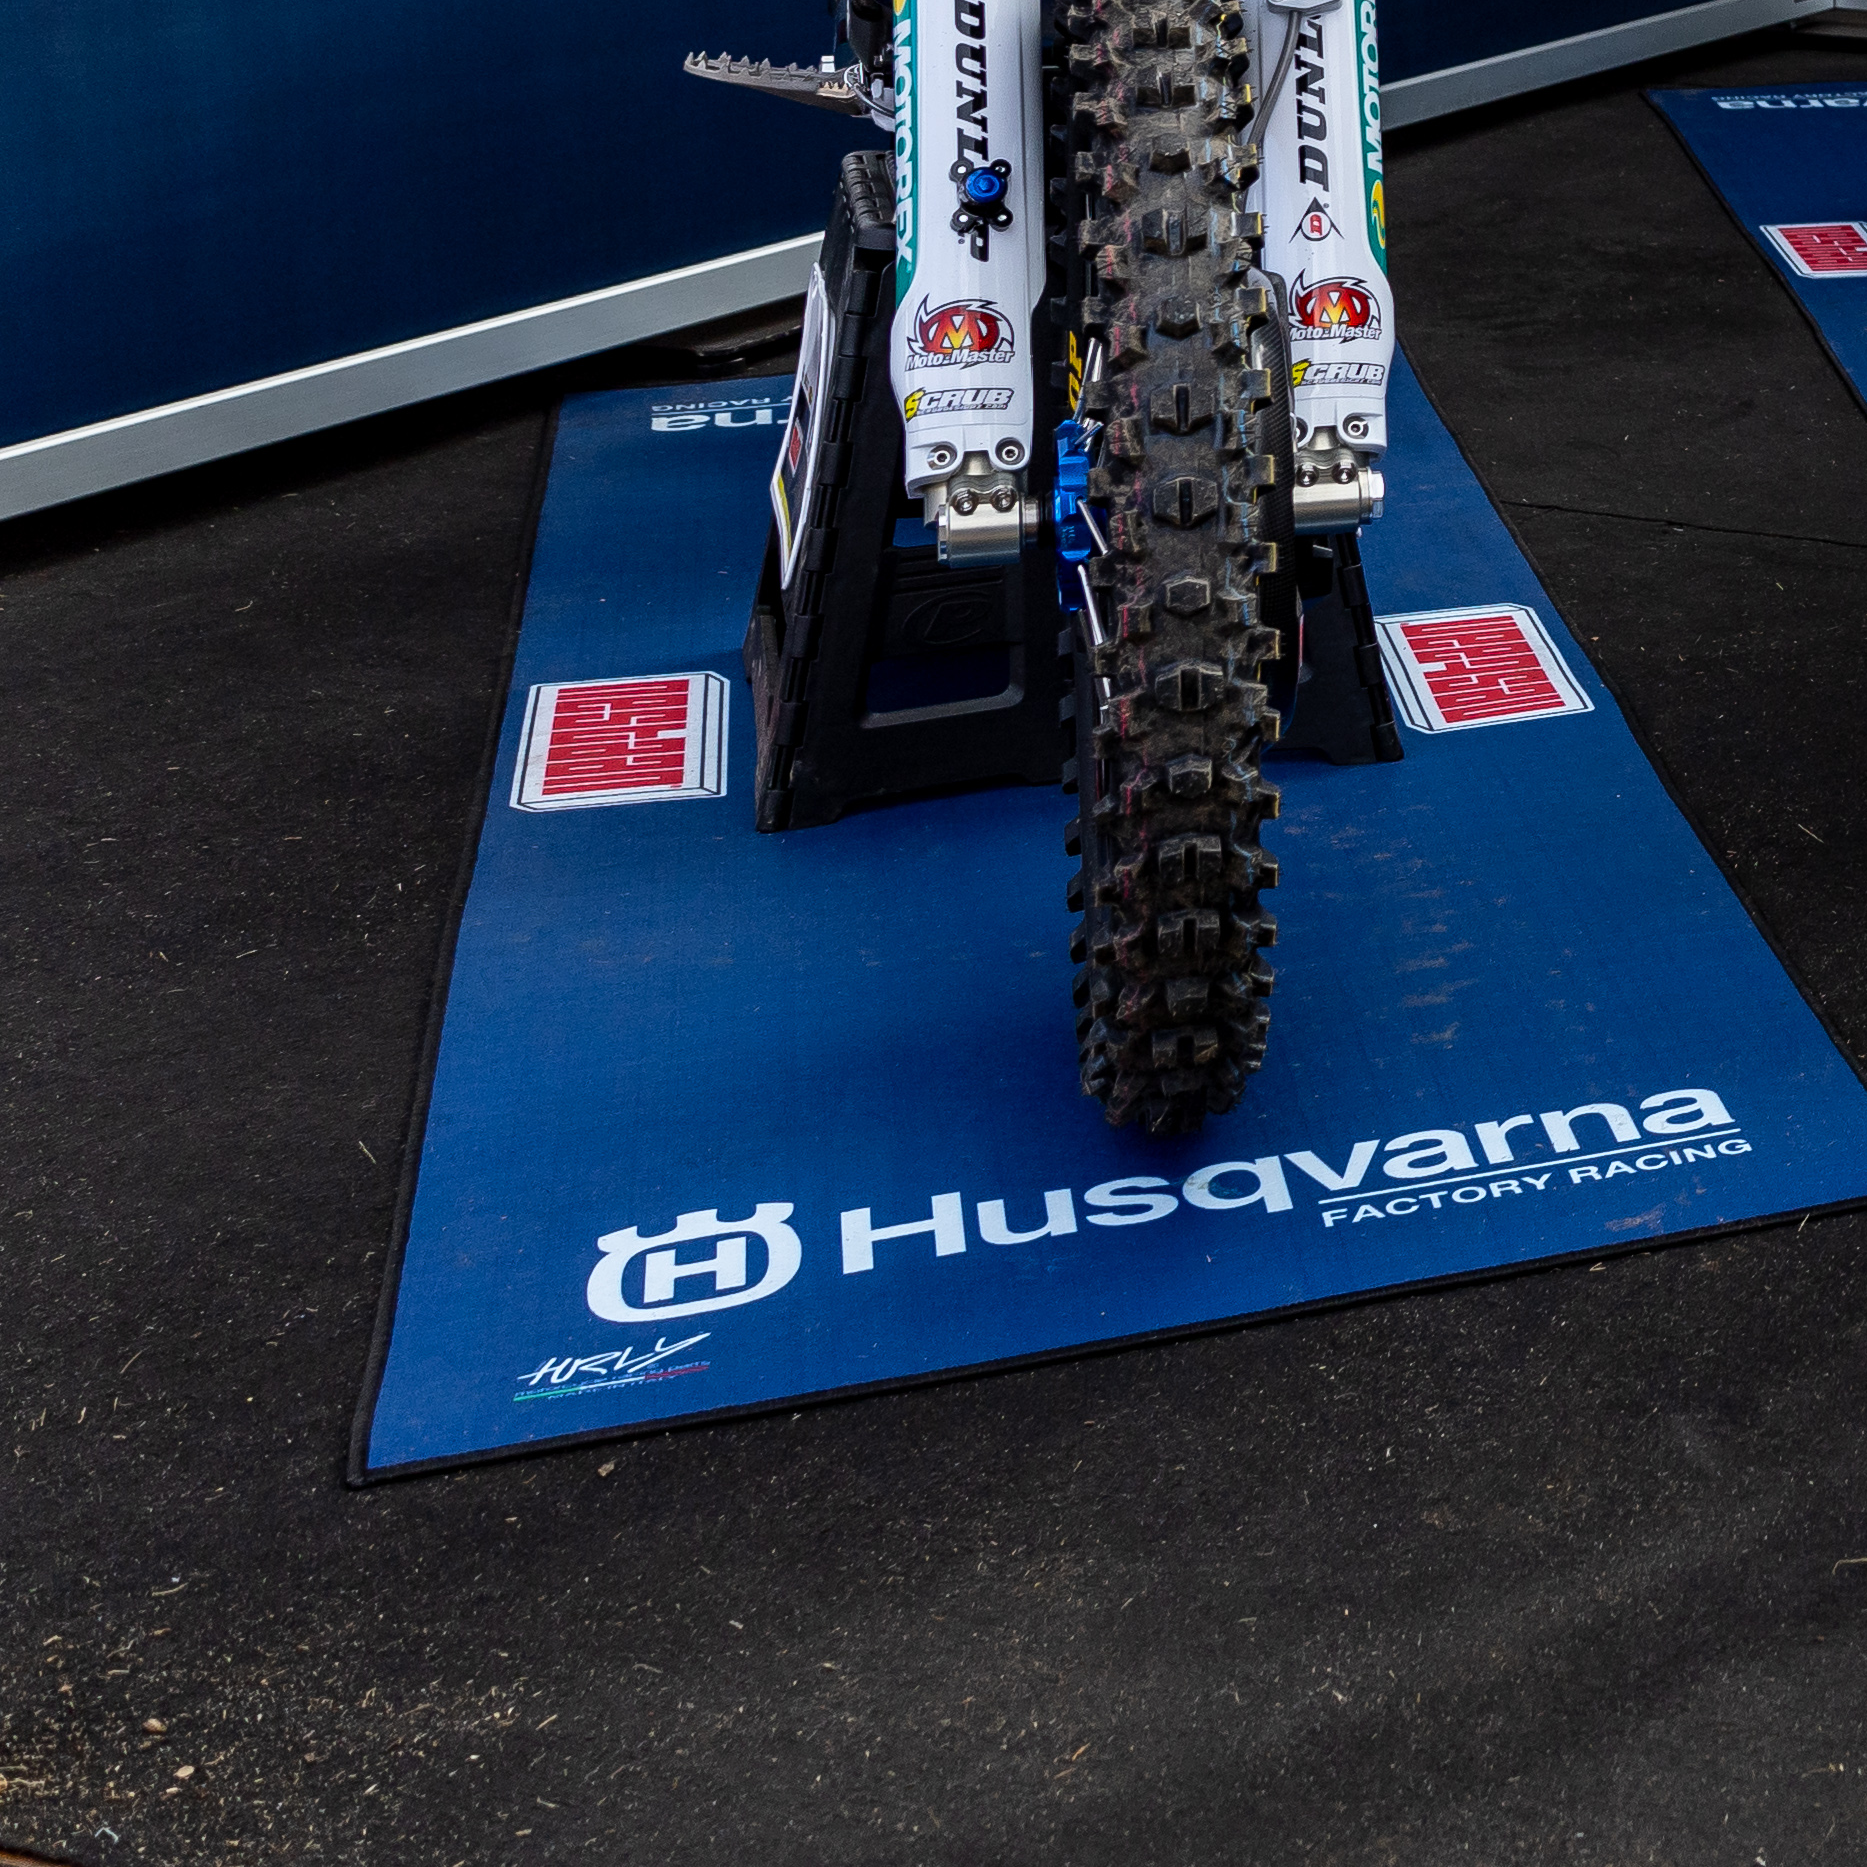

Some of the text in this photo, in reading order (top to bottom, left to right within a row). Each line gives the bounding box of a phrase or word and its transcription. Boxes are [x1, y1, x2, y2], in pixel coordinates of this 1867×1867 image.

[893, 18, 914, 264] MOTOREX
[904, 386, 1015, 423] SCRUB
[840, 1086, 1737, 1276] Husqvarna
[1321, 1136, 1754, 1228] FACTORY RACING
